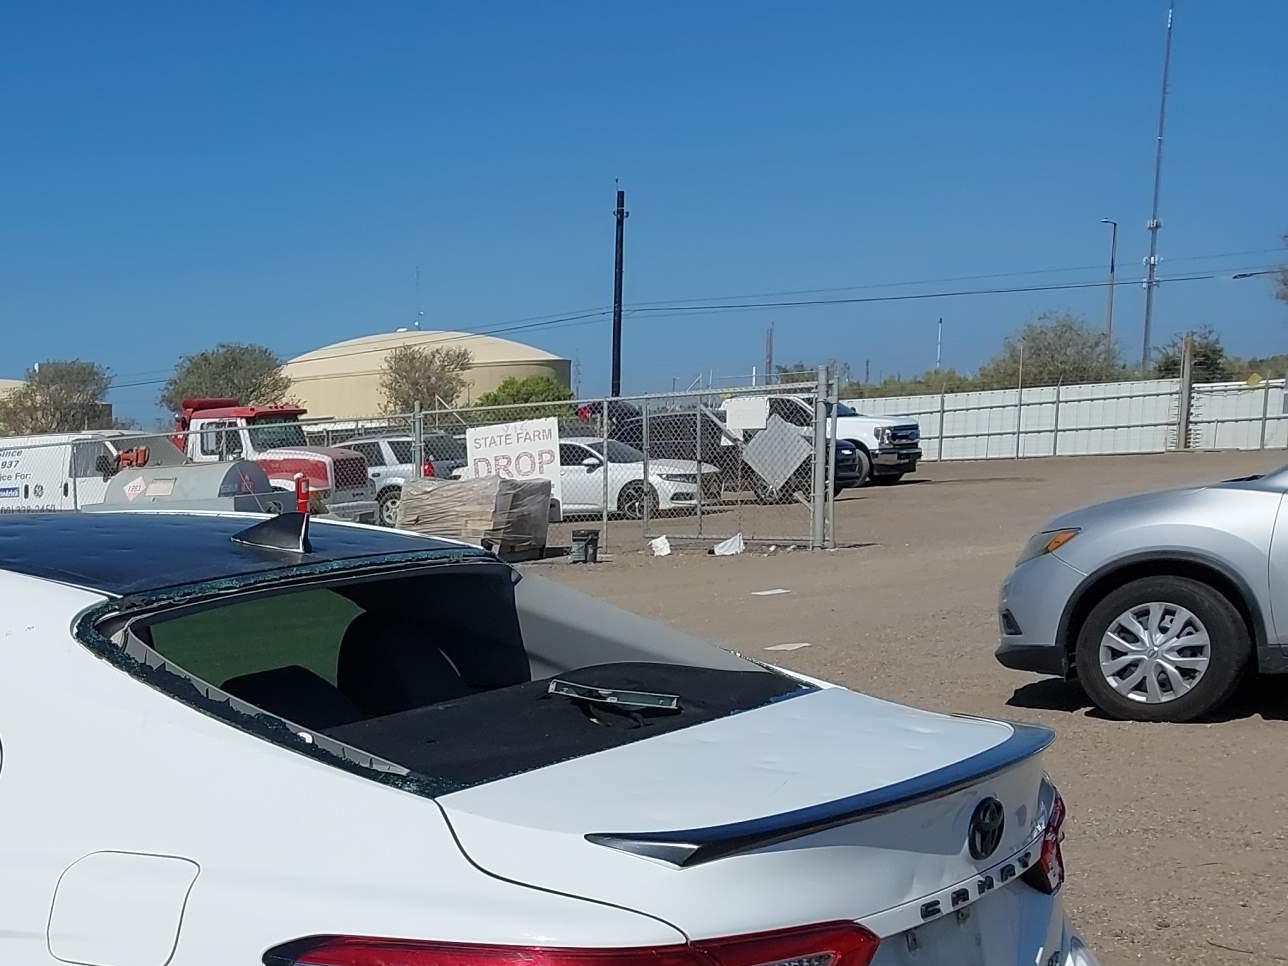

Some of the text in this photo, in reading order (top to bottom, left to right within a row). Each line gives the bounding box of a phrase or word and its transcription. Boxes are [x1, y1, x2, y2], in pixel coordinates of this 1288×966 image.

[473, 429, 553, 449] STATE FARM
[15, 472, 31, 481] For:
[473, 449, 555, 480] DROP
[920, 851, 1032, 920] CAMRY
